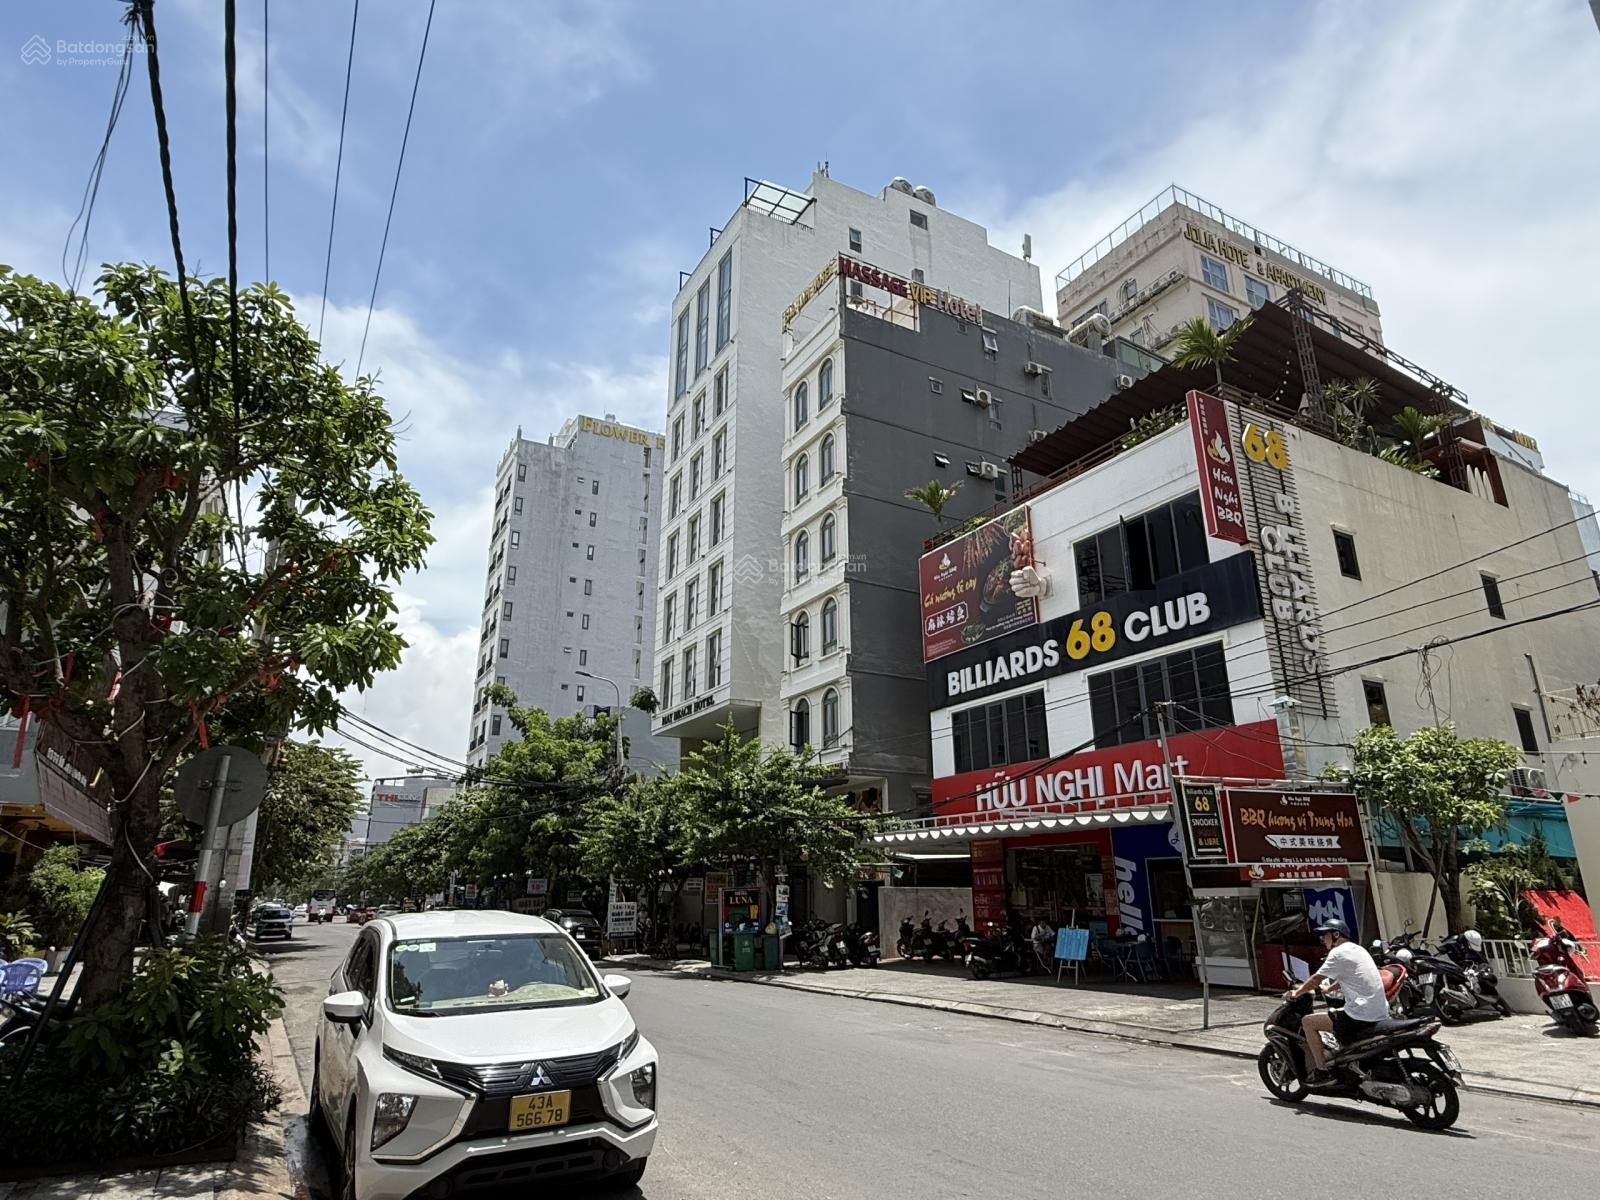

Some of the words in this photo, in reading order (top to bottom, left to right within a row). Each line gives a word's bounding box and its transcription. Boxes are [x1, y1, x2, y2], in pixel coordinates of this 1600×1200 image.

[838, 255, 908, 298] MASSAGE
[909, 281, 933, 306] VIP
[936, 288, 983, 325] Hotel
[581, 415, 649, 446] FLOWER
[1242, 422, 1289, 470] 68
[1216, 506, 1243, 528] BBQ
[1261, 526, 1294, 620] CLUB
[948, 639, 1060, 697] BILLIARDS
[1065, 611, 1116, 660] 68
[1124, 592, 1211, 643] CLUB
[1035, 764, 1106, 805] NGHỊ
[1113, 755, 1189, 794] Mart
[1194, 796, 1210, 812] 68
[1191, 818, 1219, 826] SNOOKER
[1240, 807, 1268, 829] BBQ
[1307, 810, 1336, 832] Trung
[729, 895, 754, 905] LUNA
[528, 1095, 553, 1110] 43A
[516, 1108, 563, 1128] 566.78
